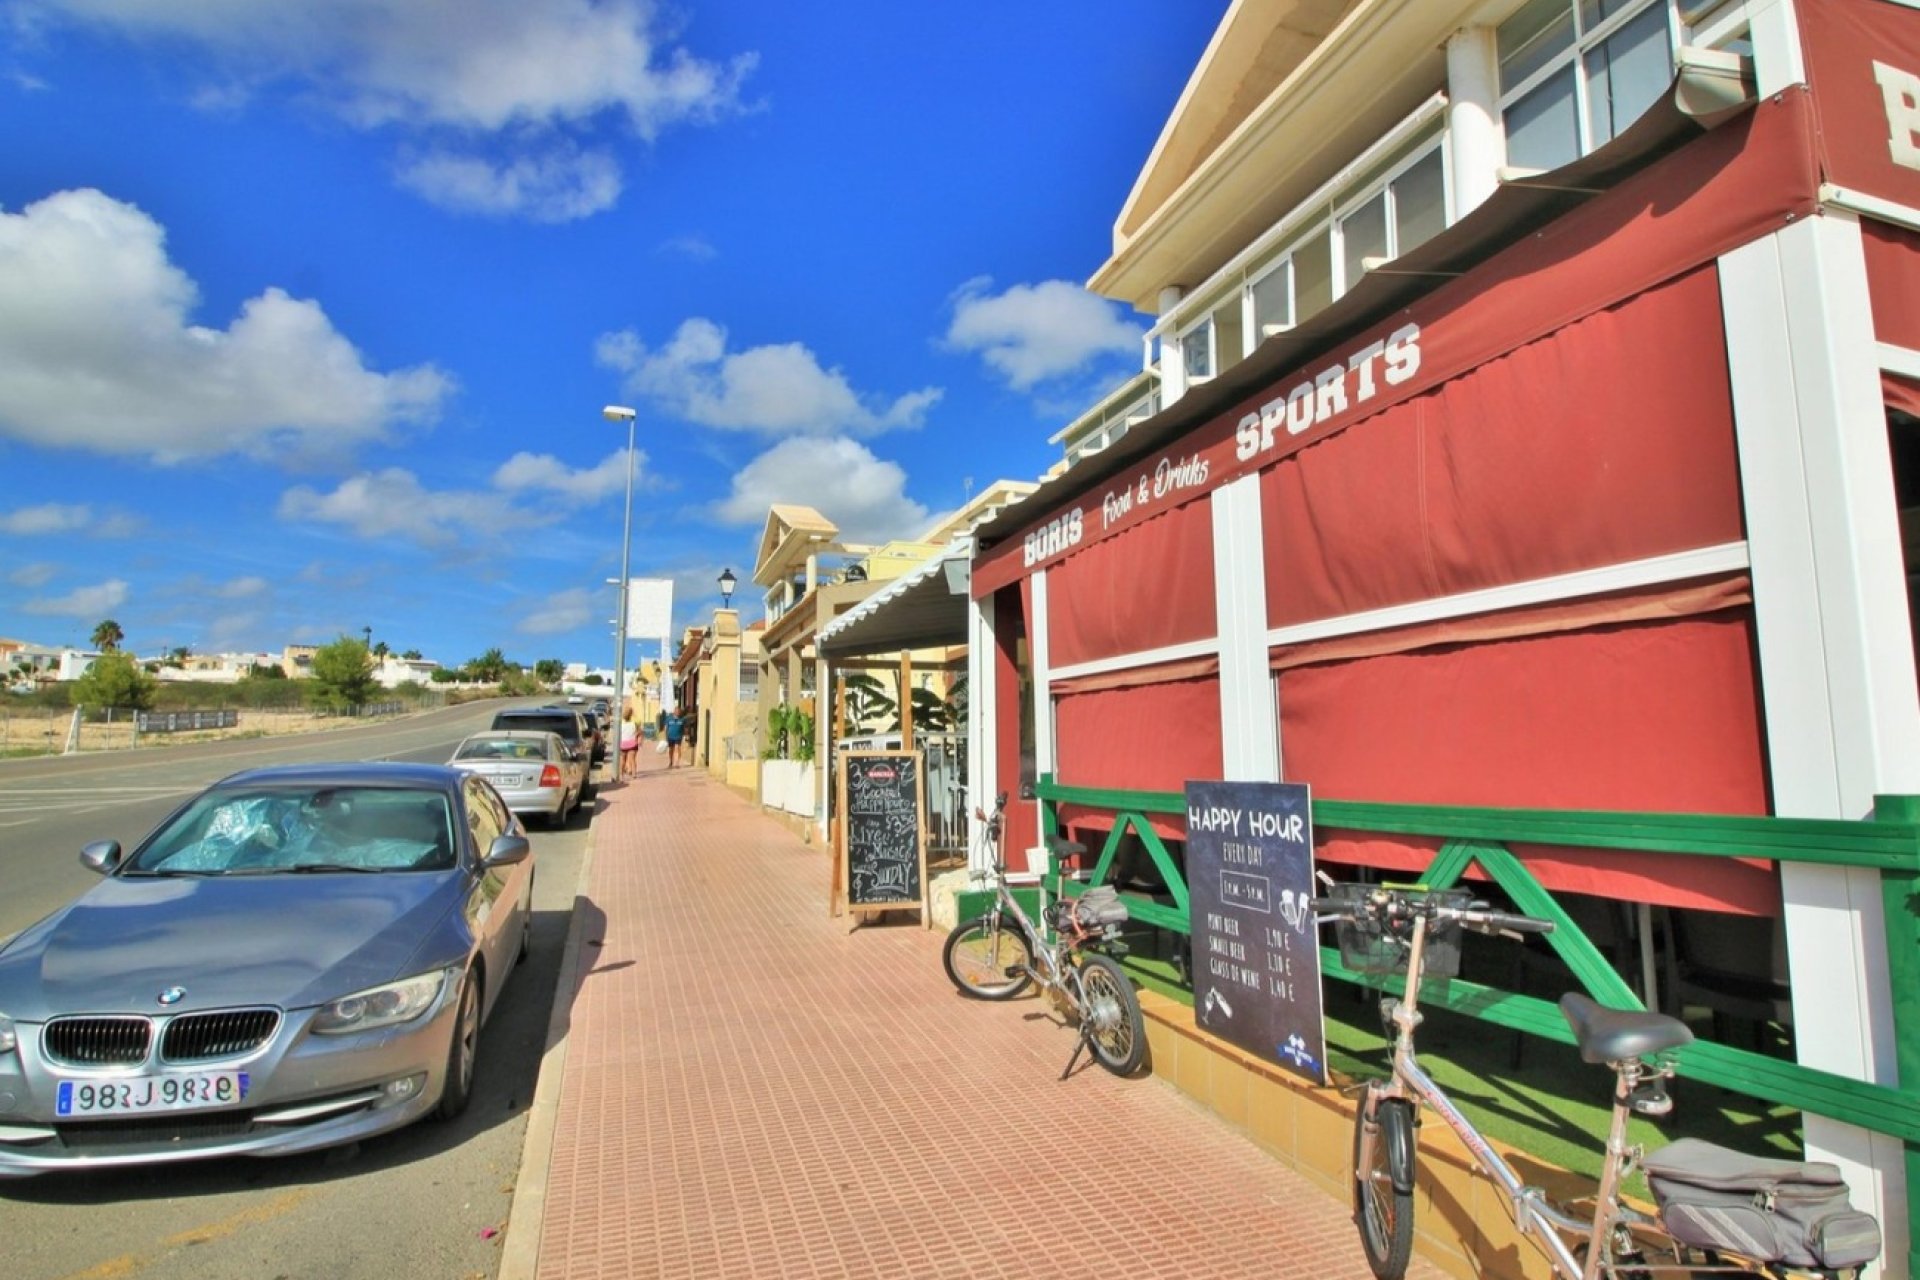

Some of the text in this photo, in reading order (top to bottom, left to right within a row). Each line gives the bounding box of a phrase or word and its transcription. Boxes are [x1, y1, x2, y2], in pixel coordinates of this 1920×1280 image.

[1235, 322, 1421, 461] SPORTS
[1103, 456, 1209, 530] Food & Drinks
[1023, 507, 1083, 568] BORIS
[1188, 806, 1305, 844] HAPPY HOUR
[1223, 842, 1262, 867] EVERY DAY
[1209, 935, 1246, 962] SMALL BEER
[1210, 957, 1230, 980] GLASS
[1241, 967, 1261, 991] WINE
